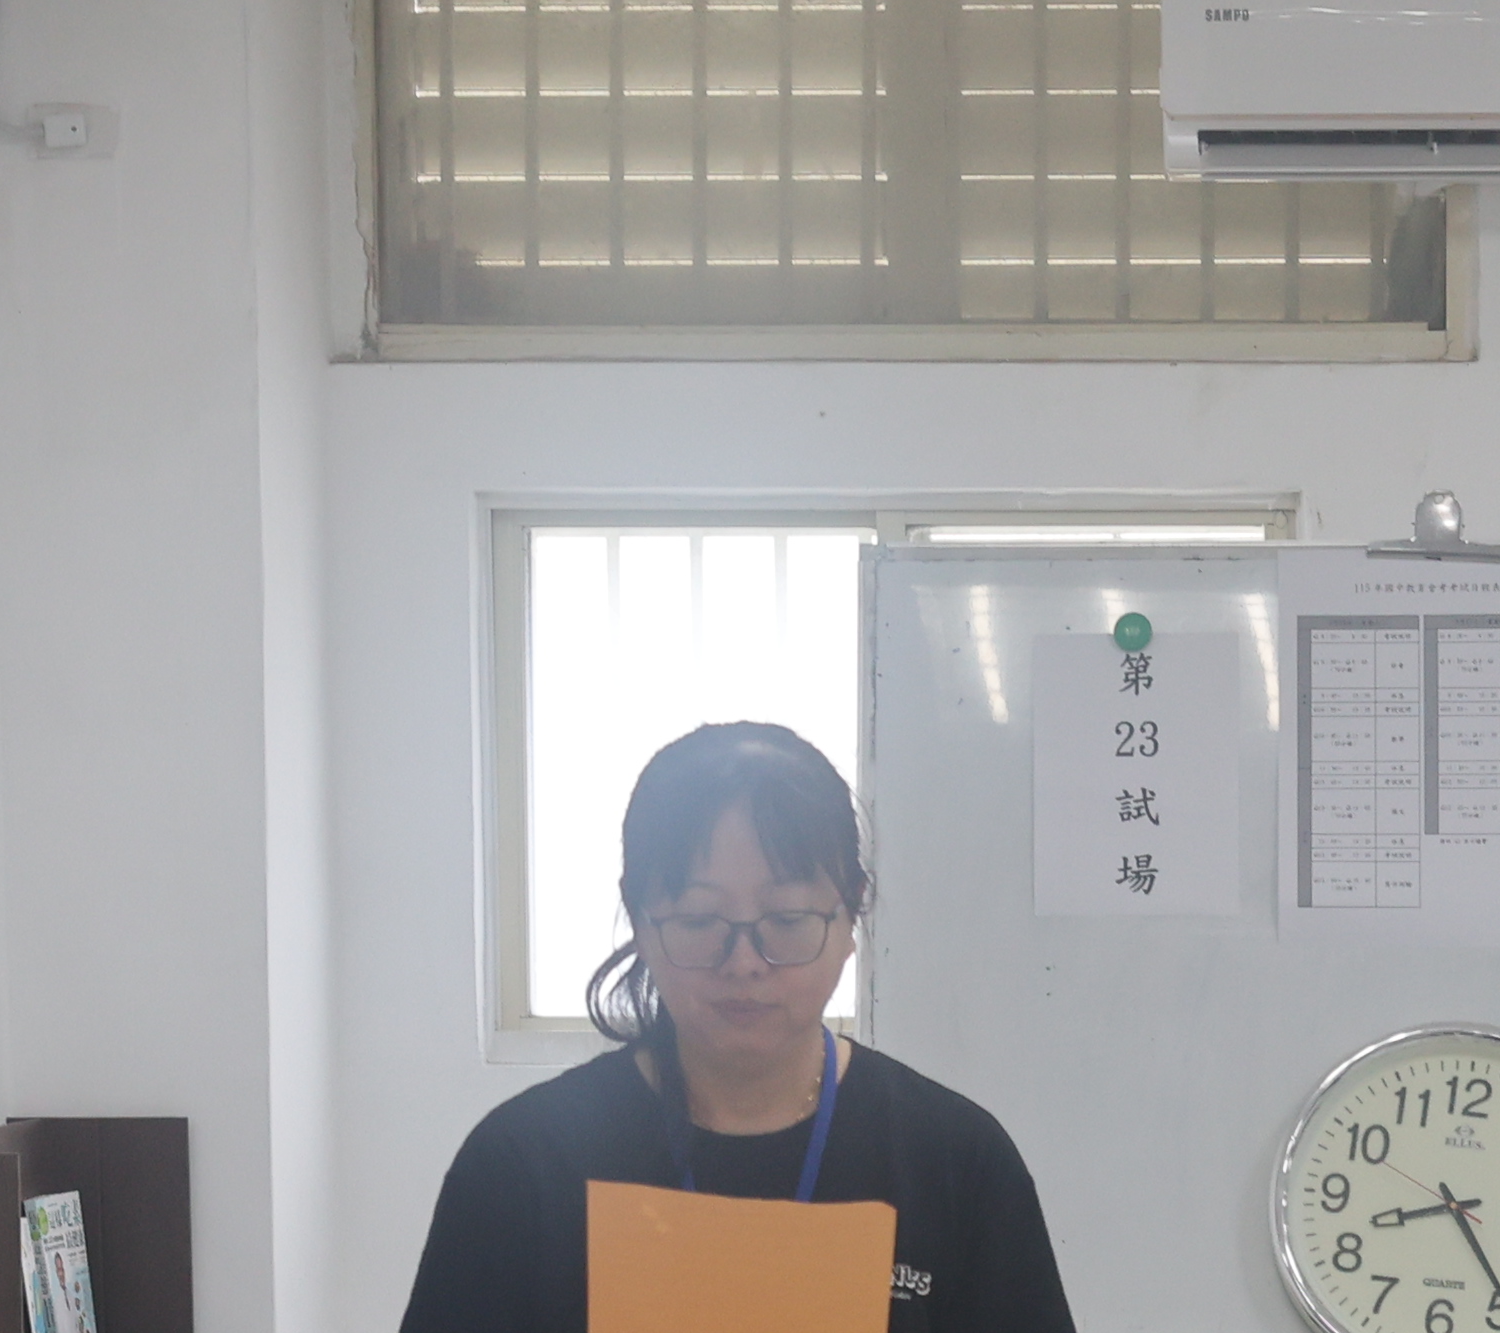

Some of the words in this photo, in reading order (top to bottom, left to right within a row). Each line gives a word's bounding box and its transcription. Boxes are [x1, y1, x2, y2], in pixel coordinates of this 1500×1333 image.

[1205, 8, 1250, 22] SAMPO
[1114, 652, 1161, 895] 第23試場
[1394, 1086, 1431, 1128] 11
[1445, 1076, 1493, 1120] 12
[1347, 1123, 1391, 1165] 10
[1320, 1172, 1351, 1214] 9
[1331, 1232, 1363, 1273] 8
[1370, 1274, 1400, 1315] 7
